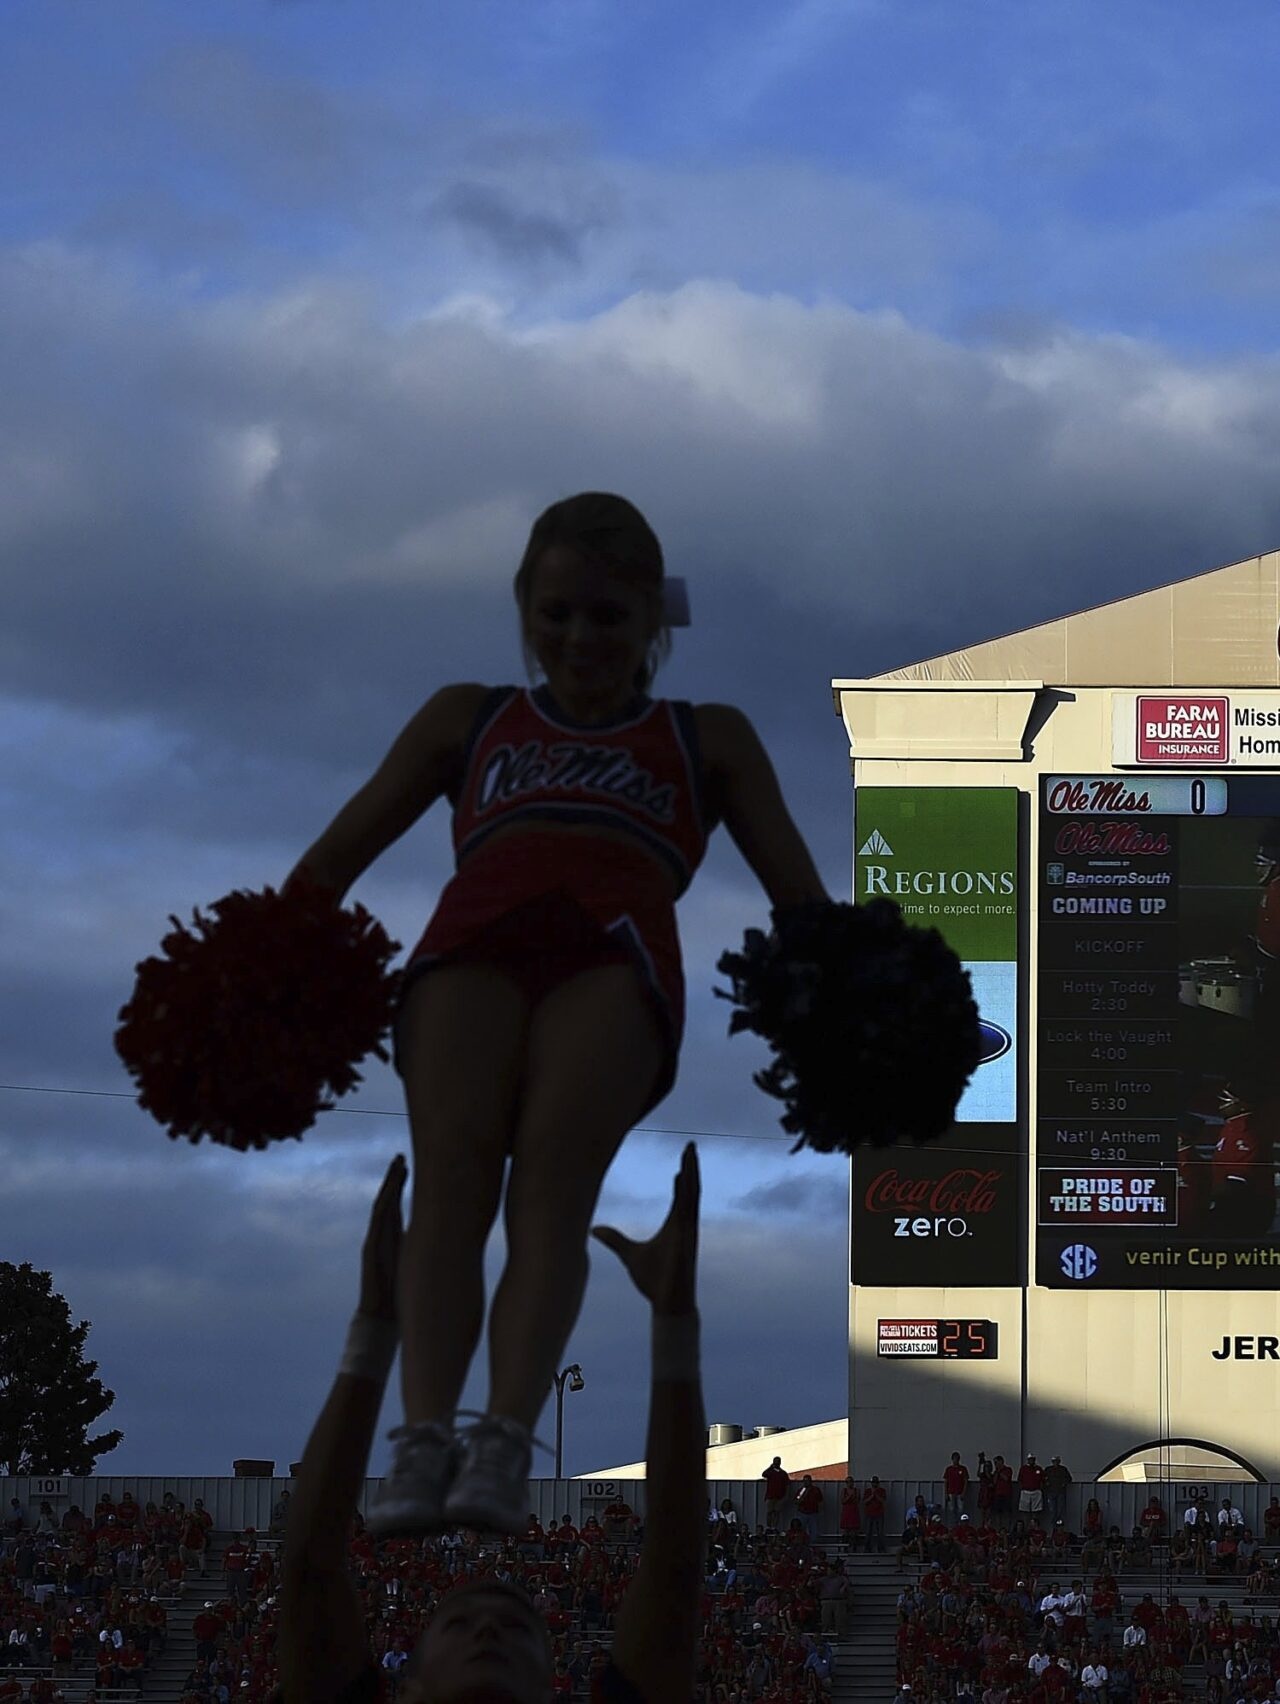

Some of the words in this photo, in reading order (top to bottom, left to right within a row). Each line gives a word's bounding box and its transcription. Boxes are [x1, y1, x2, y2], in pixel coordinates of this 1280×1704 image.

[1166, 705, 1220, 722] FARM
[1145, 723, 1220, 739] BUREAU
[1158, 744, 1220, 755] INSURANCE
[1049, 780, 1091, 812] Ole
[1089, 780, 1152, 812] Miss
[1191, 779, 1206, 814] 0
[1055, 821, 1102, 855] Ole
[1100, 821, 1172, 855] Miss
[1065, 871, 1172, 886] BancorpSouth
[929, 903, 940, 914] to
[943, 903, 980, 916] expect
[984, 904, 1016, 914] more.
[1052, 897, 1133, 915] COMING
[1139, 897, 1167, 915] UP
[1074, 940, 1145, 953] KICKOFF
[1062, 980, 1104, 995] Hotty
[1109, 980, 1156, 996] Toddy
[1090, 998, 1127, 1011] 2:30
[1047, 1030, 1082, 1042] Lock
[1088, 1030, 1113, 1042] the
[1119, 1030, 1172, 1046] Vaught
[1090, 1047, 1127, 1060] 4:00
[1065, 1079, 1108, 1093] Team
[1114, 1080, 1152, 1093] Intro
[1090, 1097, 1127, 1111] 5:30
[1056, 1130, 1094, 1143] Nat'l
[1100, 1130, 1161, 1143] Anthem
[1090, 1147, 1127, 1161] 9:30
[864, 1168, 1002, 1213] Coca-Cola
[1061, 1178, 1124, 1195] PRIDE
[1129, 1178, 1157, 1195] OF
[1049, 1195, 1092, 1212] THE
[1097, 1195, 1167, 1213] SOUTH
[1060, 1243, 1098, 1280] SEC
[1125, 1247, 1182, 1265] venir
[1187, 1248, 1228, 1270] Cup
[901, 1325, 938, 1337] TICKETS
[943, 1322, 985, 1353] 25
[880, 1343, 937, 1353] VIVIDSEATS.COM
[37, 1478, 62, 1493] 101
[586, 1481, 615, 1497] 102
[1182, 1485, 1209, 1499] 103
